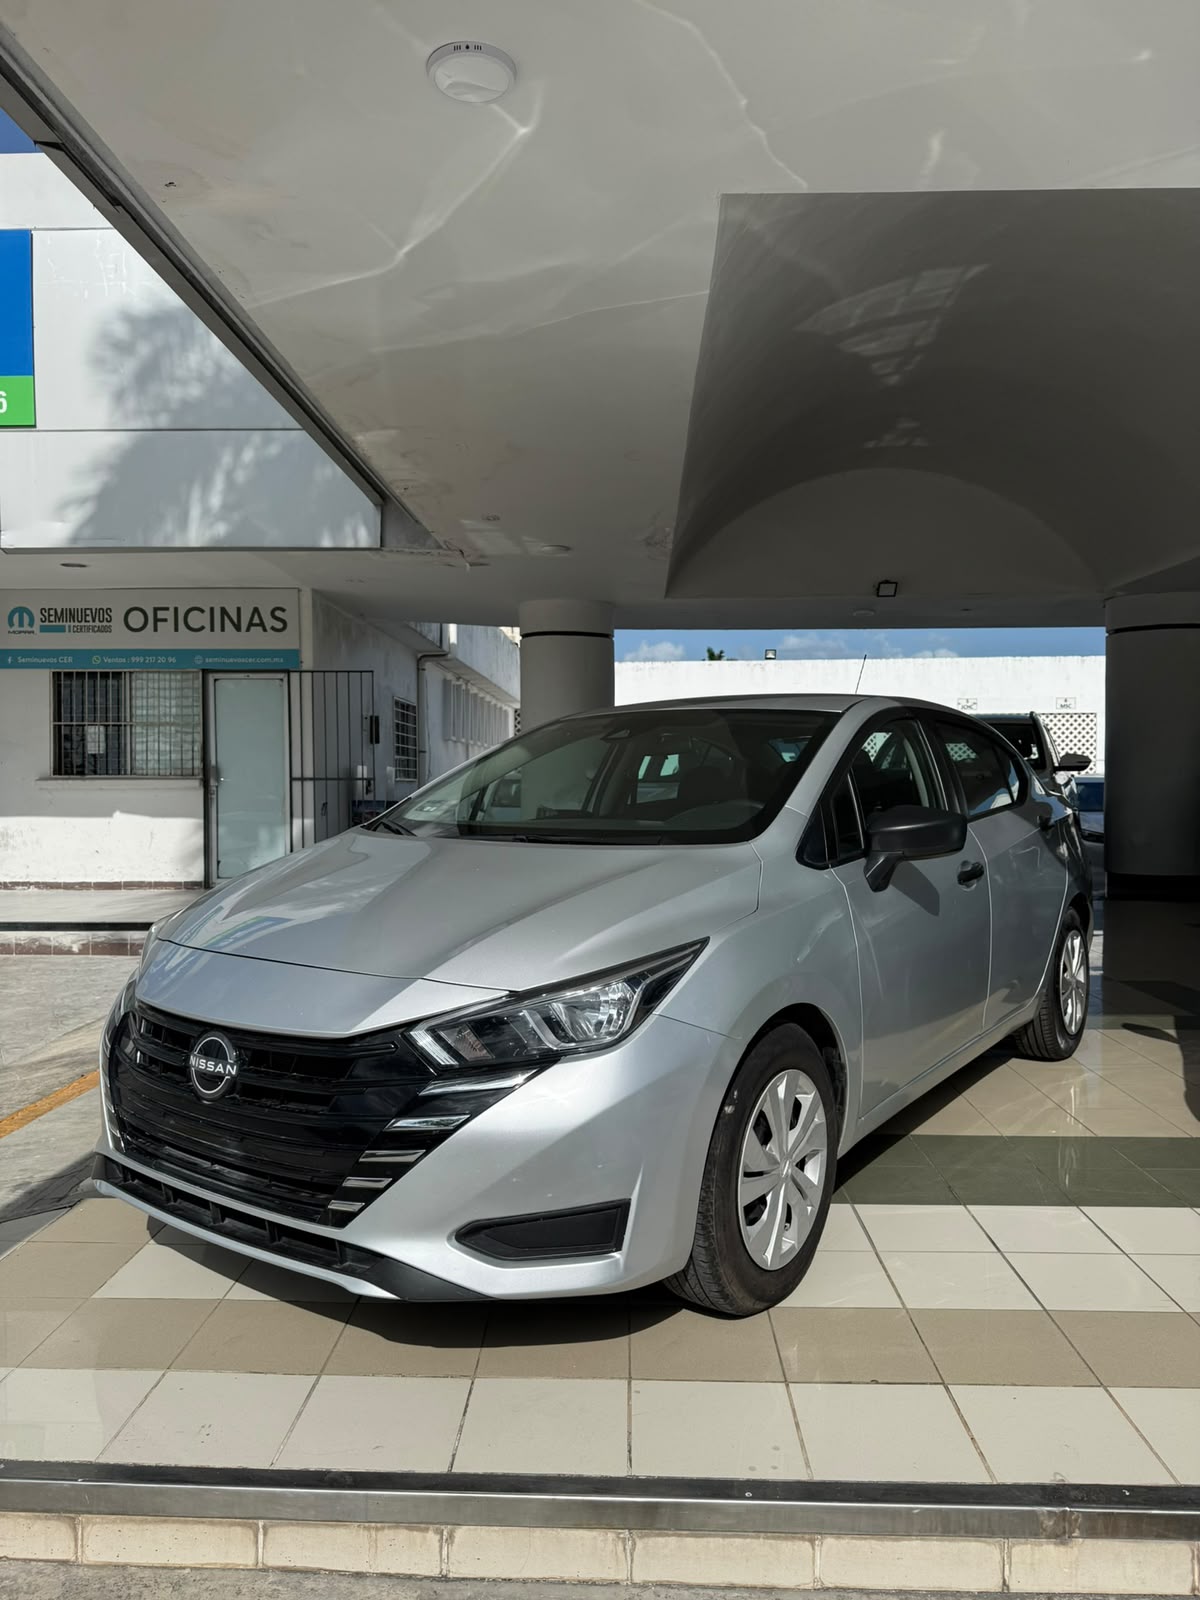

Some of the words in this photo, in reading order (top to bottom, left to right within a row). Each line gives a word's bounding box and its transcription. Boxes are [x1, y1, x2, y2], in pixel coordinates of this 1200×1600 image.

[40, 607, 112, 623] SEMINUEVOS
[123, 606, 288, 633] OFICINAS
[72, 624, 112, 633] CERTIFICADOS
[17, 655, 57, 664] Seminuevos
[131, 655, 144, 664] 999
[157, 655, 167, 664] 20
[167, 655, 177, 664] 96
[189, 1054, 237, 1075] NISSAN
